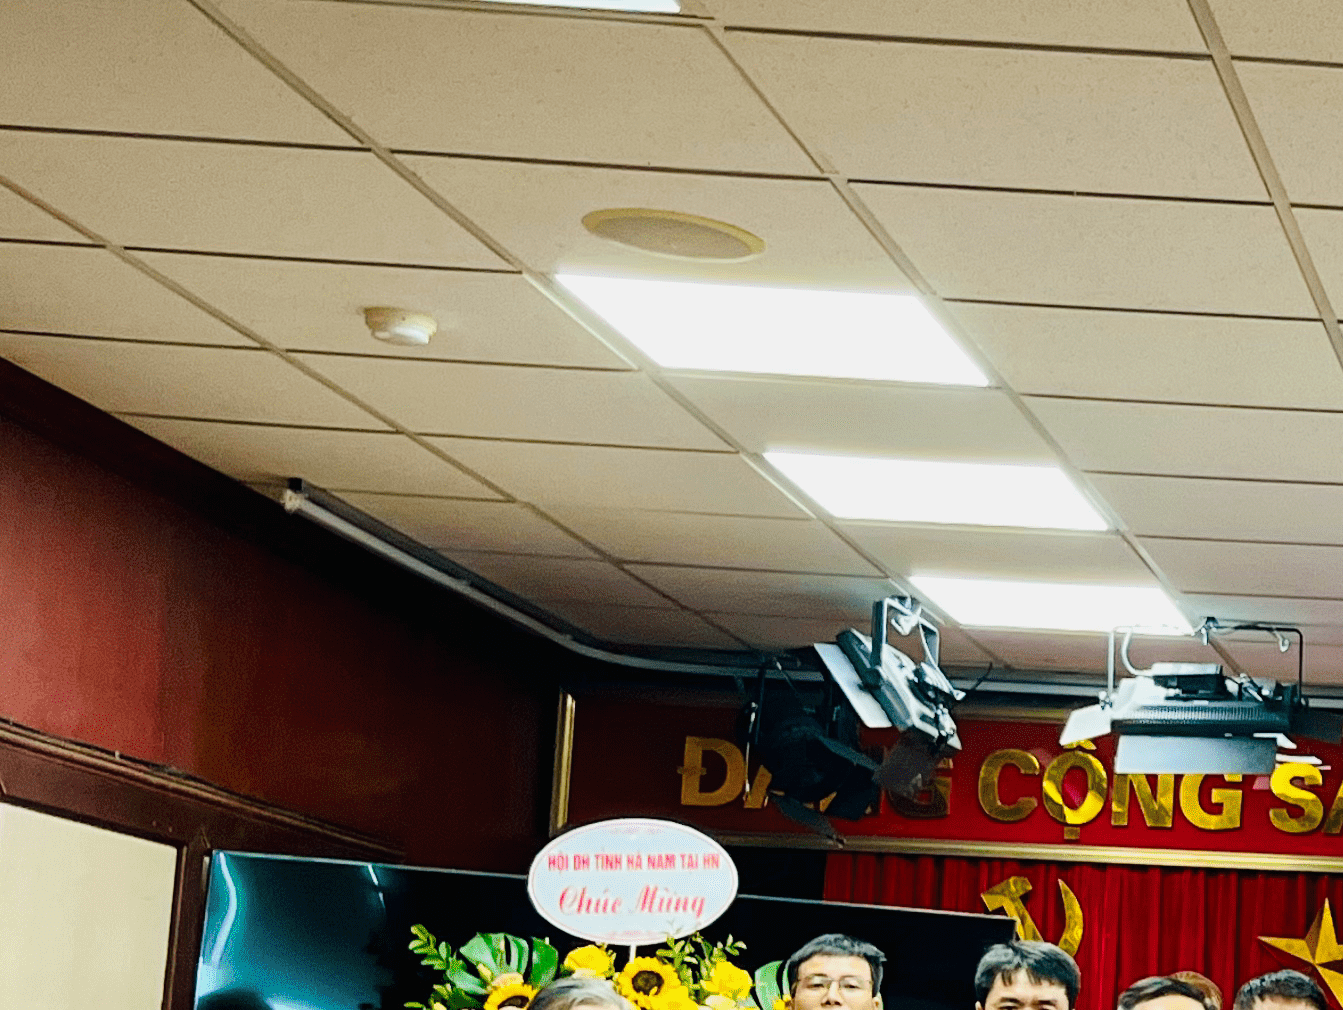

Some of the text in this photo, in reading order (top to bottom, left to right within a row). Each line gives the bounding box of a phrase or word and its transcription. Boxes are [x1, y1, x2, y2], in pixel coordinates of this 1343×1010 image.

[977, 738, 1243, 840] CỘNG
[647, 853, 676, 871] NAM
[703, 853, 720, 871] HN
[558, 886, 622, 915] Chúc
